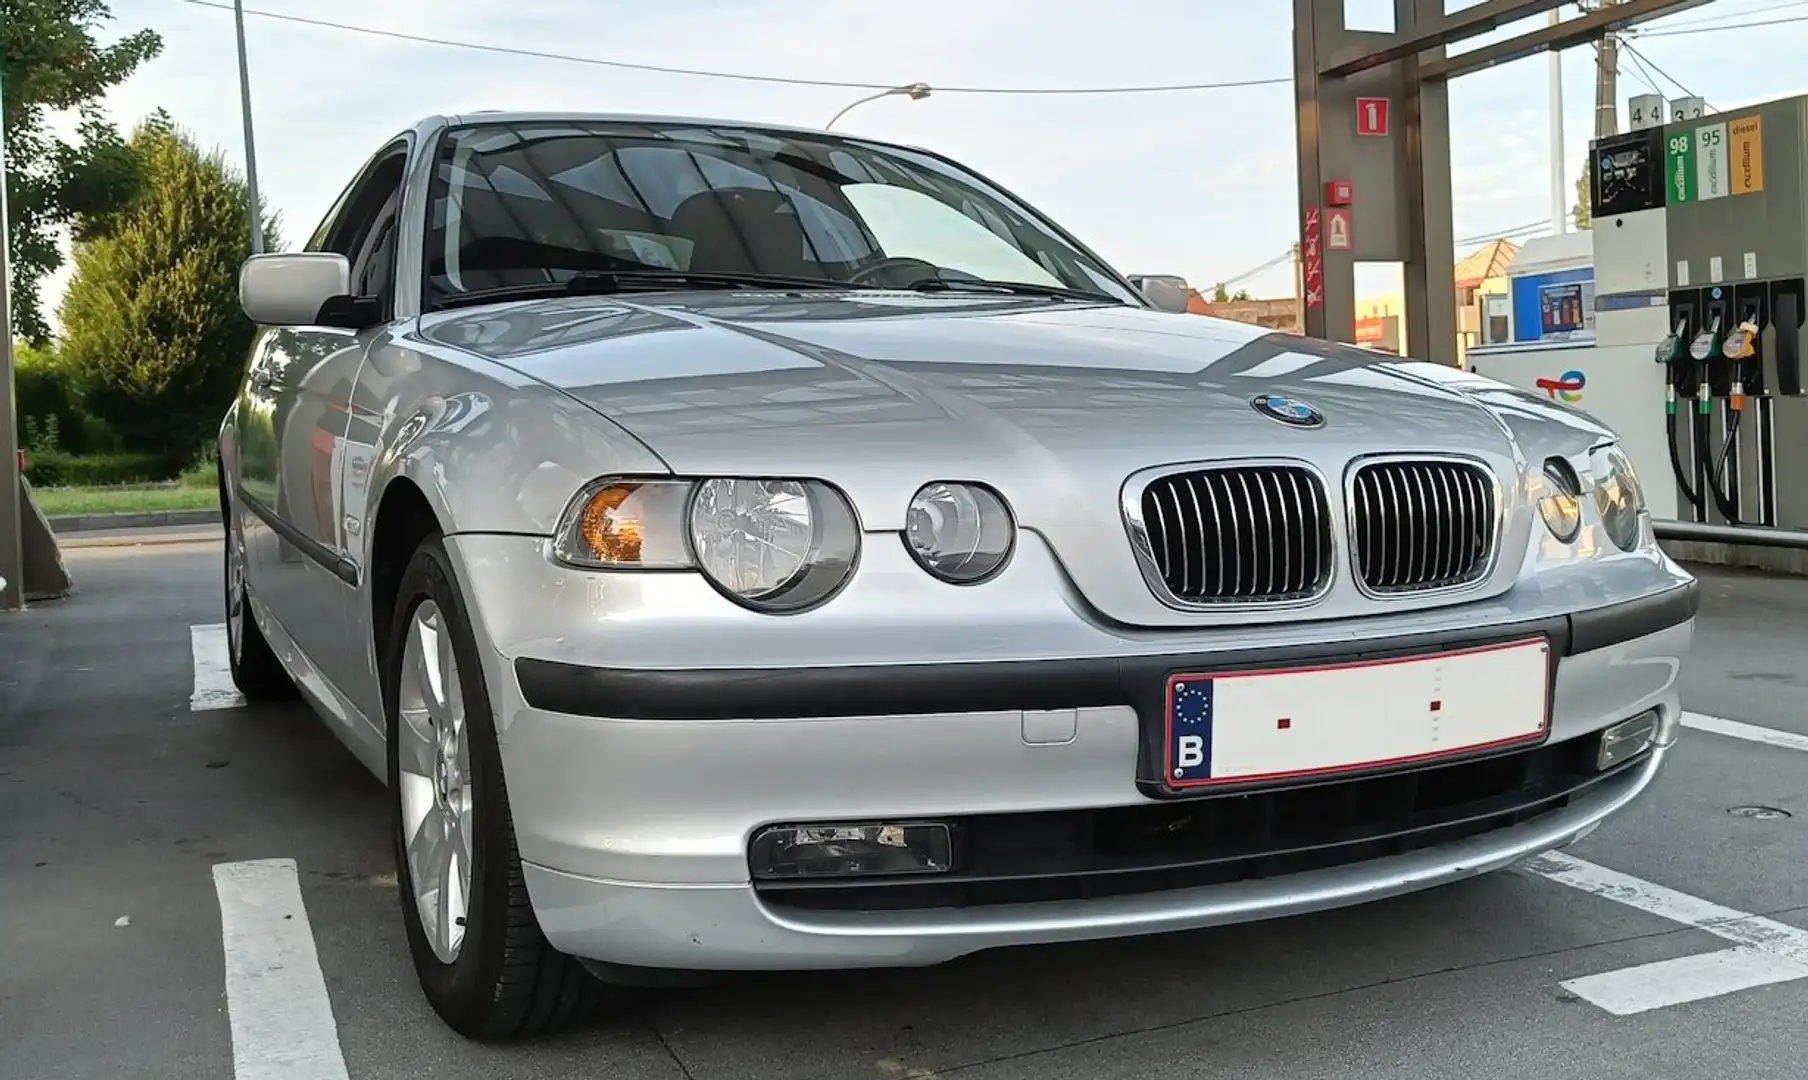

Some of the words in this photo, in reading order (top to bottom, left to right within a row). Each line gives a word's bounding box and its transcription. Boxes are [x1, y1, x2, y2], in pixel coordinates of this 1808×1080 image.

[1632, 107, 1643, 124] 4
[1651, 106, 1660, 122] 4
[1732, 122, 1758, 136] diesel
[1669, 136, 1689, 155] 98
[1701, 129, 1721, 147] 95
[1178, 735, 1204, 768] B
